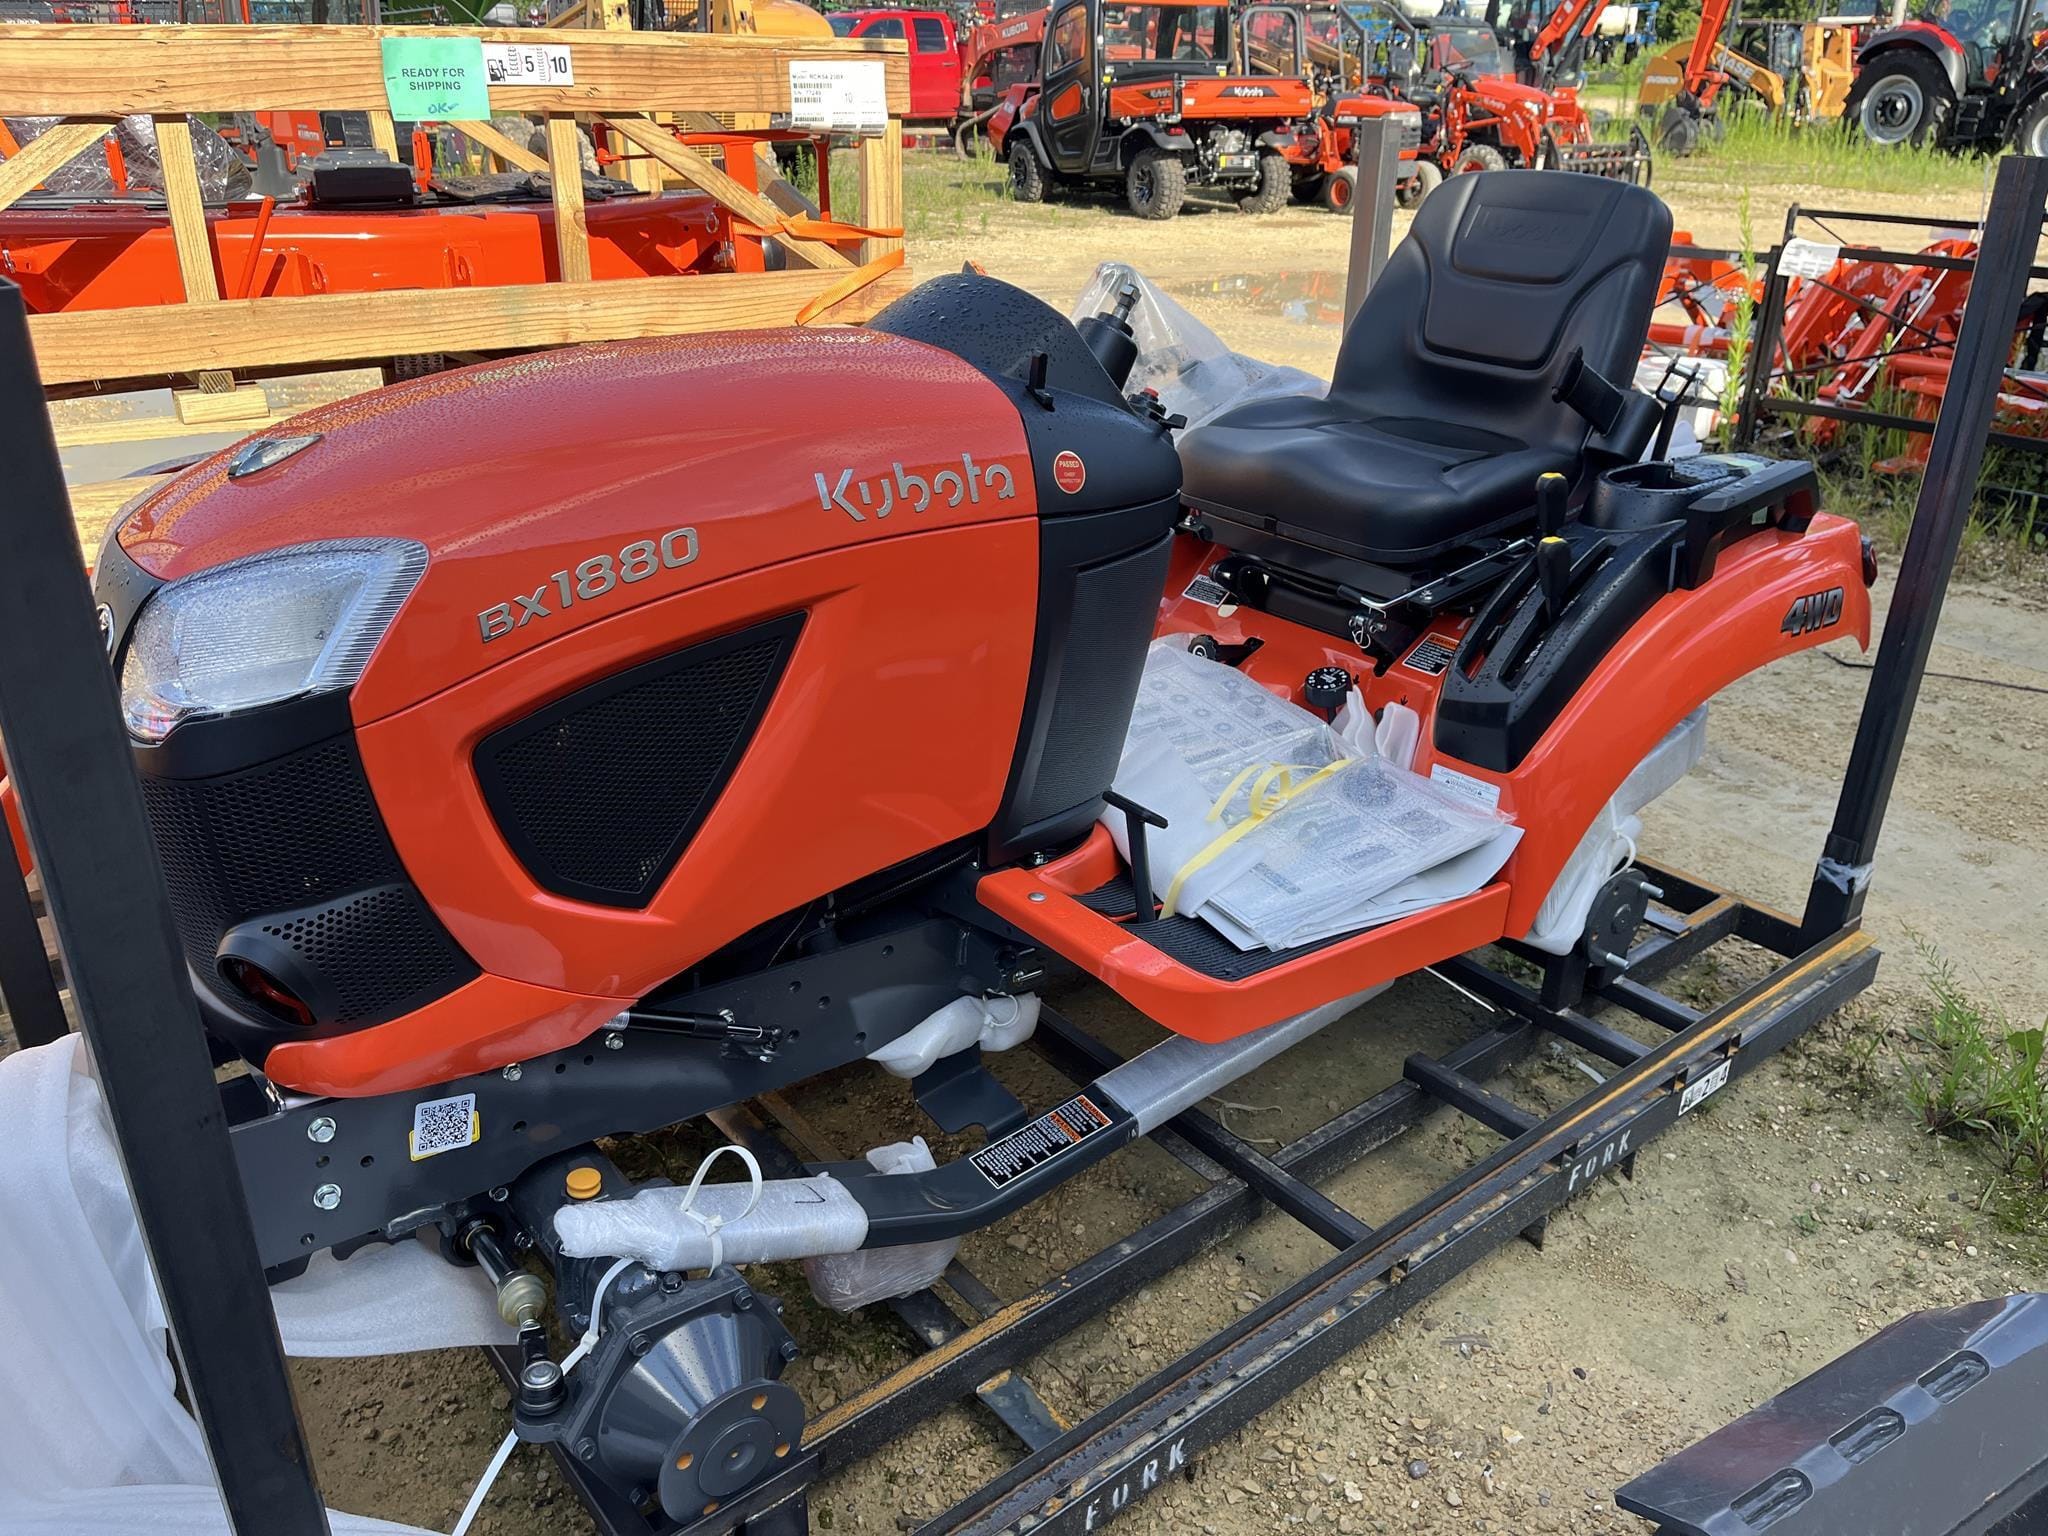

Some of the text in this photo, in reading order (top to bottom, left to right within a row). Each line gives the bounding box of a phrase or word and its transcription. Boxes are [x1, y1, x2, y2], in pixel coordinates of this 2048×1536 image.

[1002, 22, 1029, 38] KUBOTA
[402, 68, 465, 77] READY FOR
[525, 56, 534, 72] 5
[551, 56, 567, 73] 10
[1716, 52, 1755, 78] CASE
[409, 81, 461, 91] SHIPPING
[1234, 86, 1264, 97] Kubota
[1058, 460, 1080, 468] PASSED
[814, 453, 1015, 521] Kubota
[477, 527, 699, 643] BX1880
[1780, 587, 1844, 637] 4WD
[1720, 1065, 1728, 1082] 4
[1702, 1078, 1710, 1097] 2
